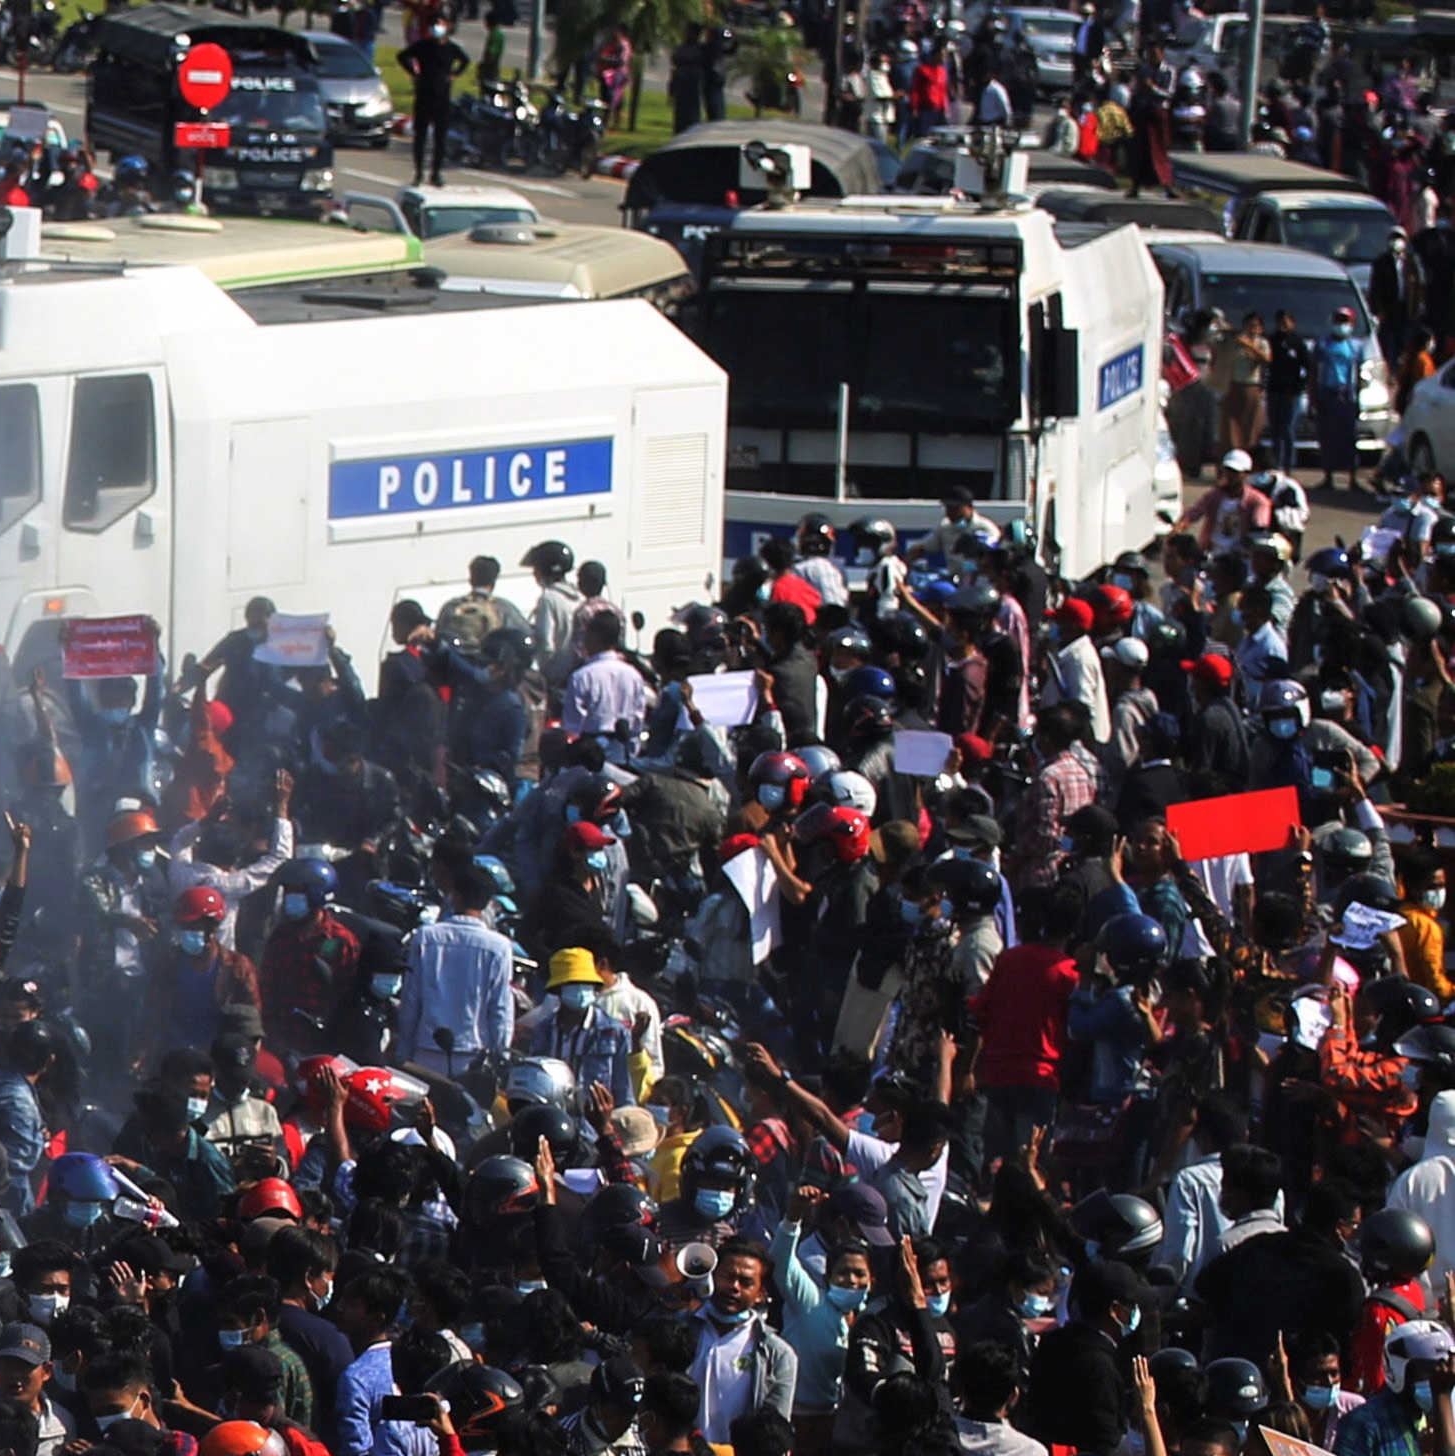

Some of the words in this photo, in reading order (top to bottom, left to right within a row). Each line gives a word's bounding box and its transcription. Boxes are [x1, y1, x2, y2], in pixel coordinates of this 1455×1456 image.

[230, 77, 295, 91] POLICE
[238, 147, 302, 162] POLICE
[378, 450, 567, 511] POLICE
